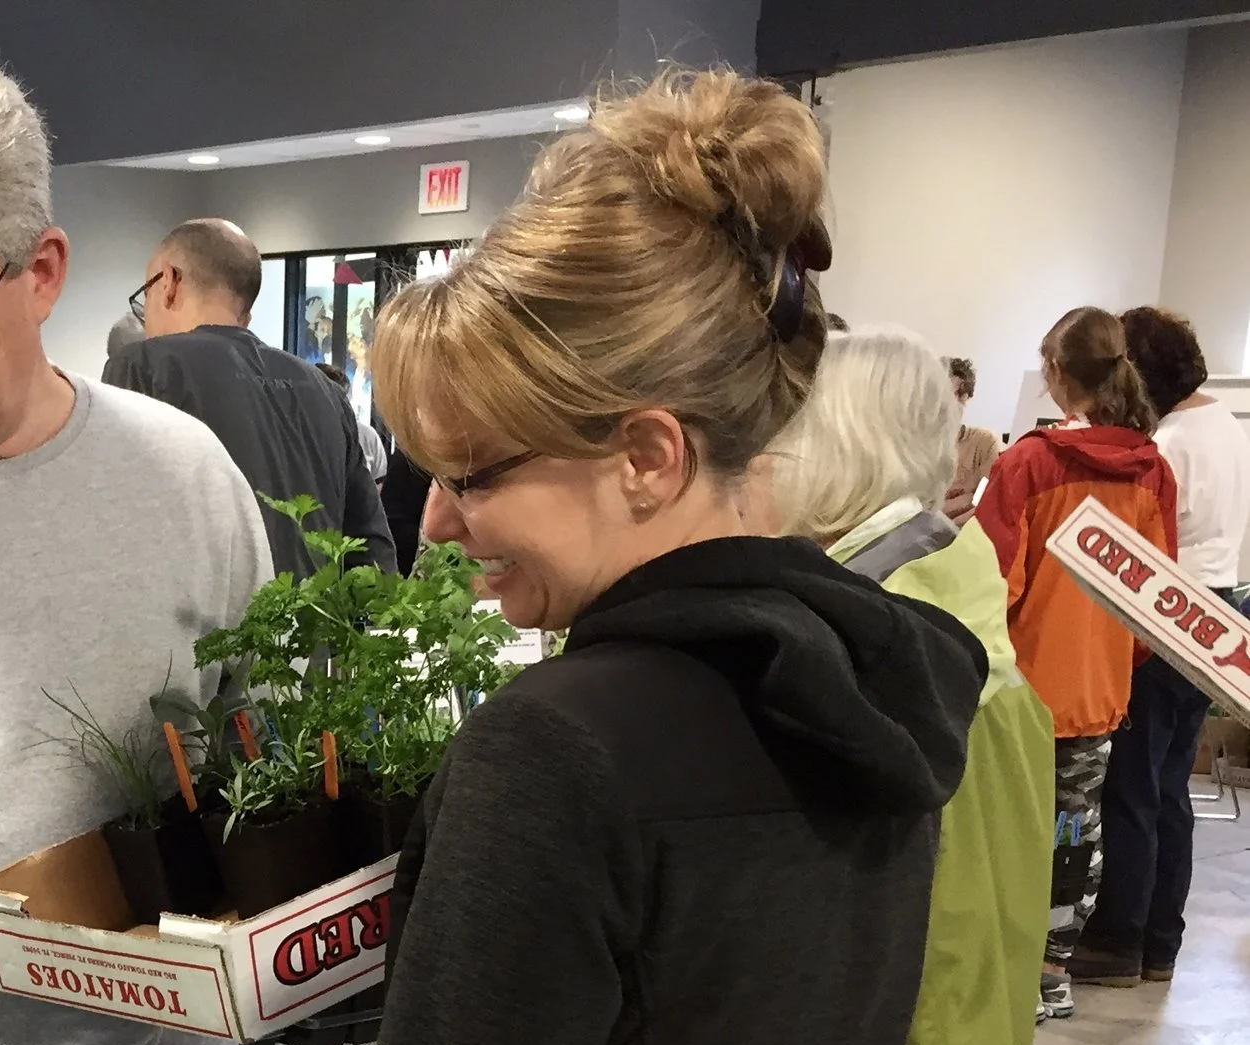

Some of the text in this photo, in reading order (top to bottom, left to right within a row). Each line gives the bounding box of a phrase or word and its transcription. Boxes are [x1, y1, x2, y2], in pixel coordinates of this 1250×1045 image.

[428, 167, 461, 206] EXIT
[1076, 525, 1229, 650] BIG RED
[273, 891, 392, 986] RED
[26, 962, 187, 1017] TOMATOES
[146, 968, 162, 979] RED
